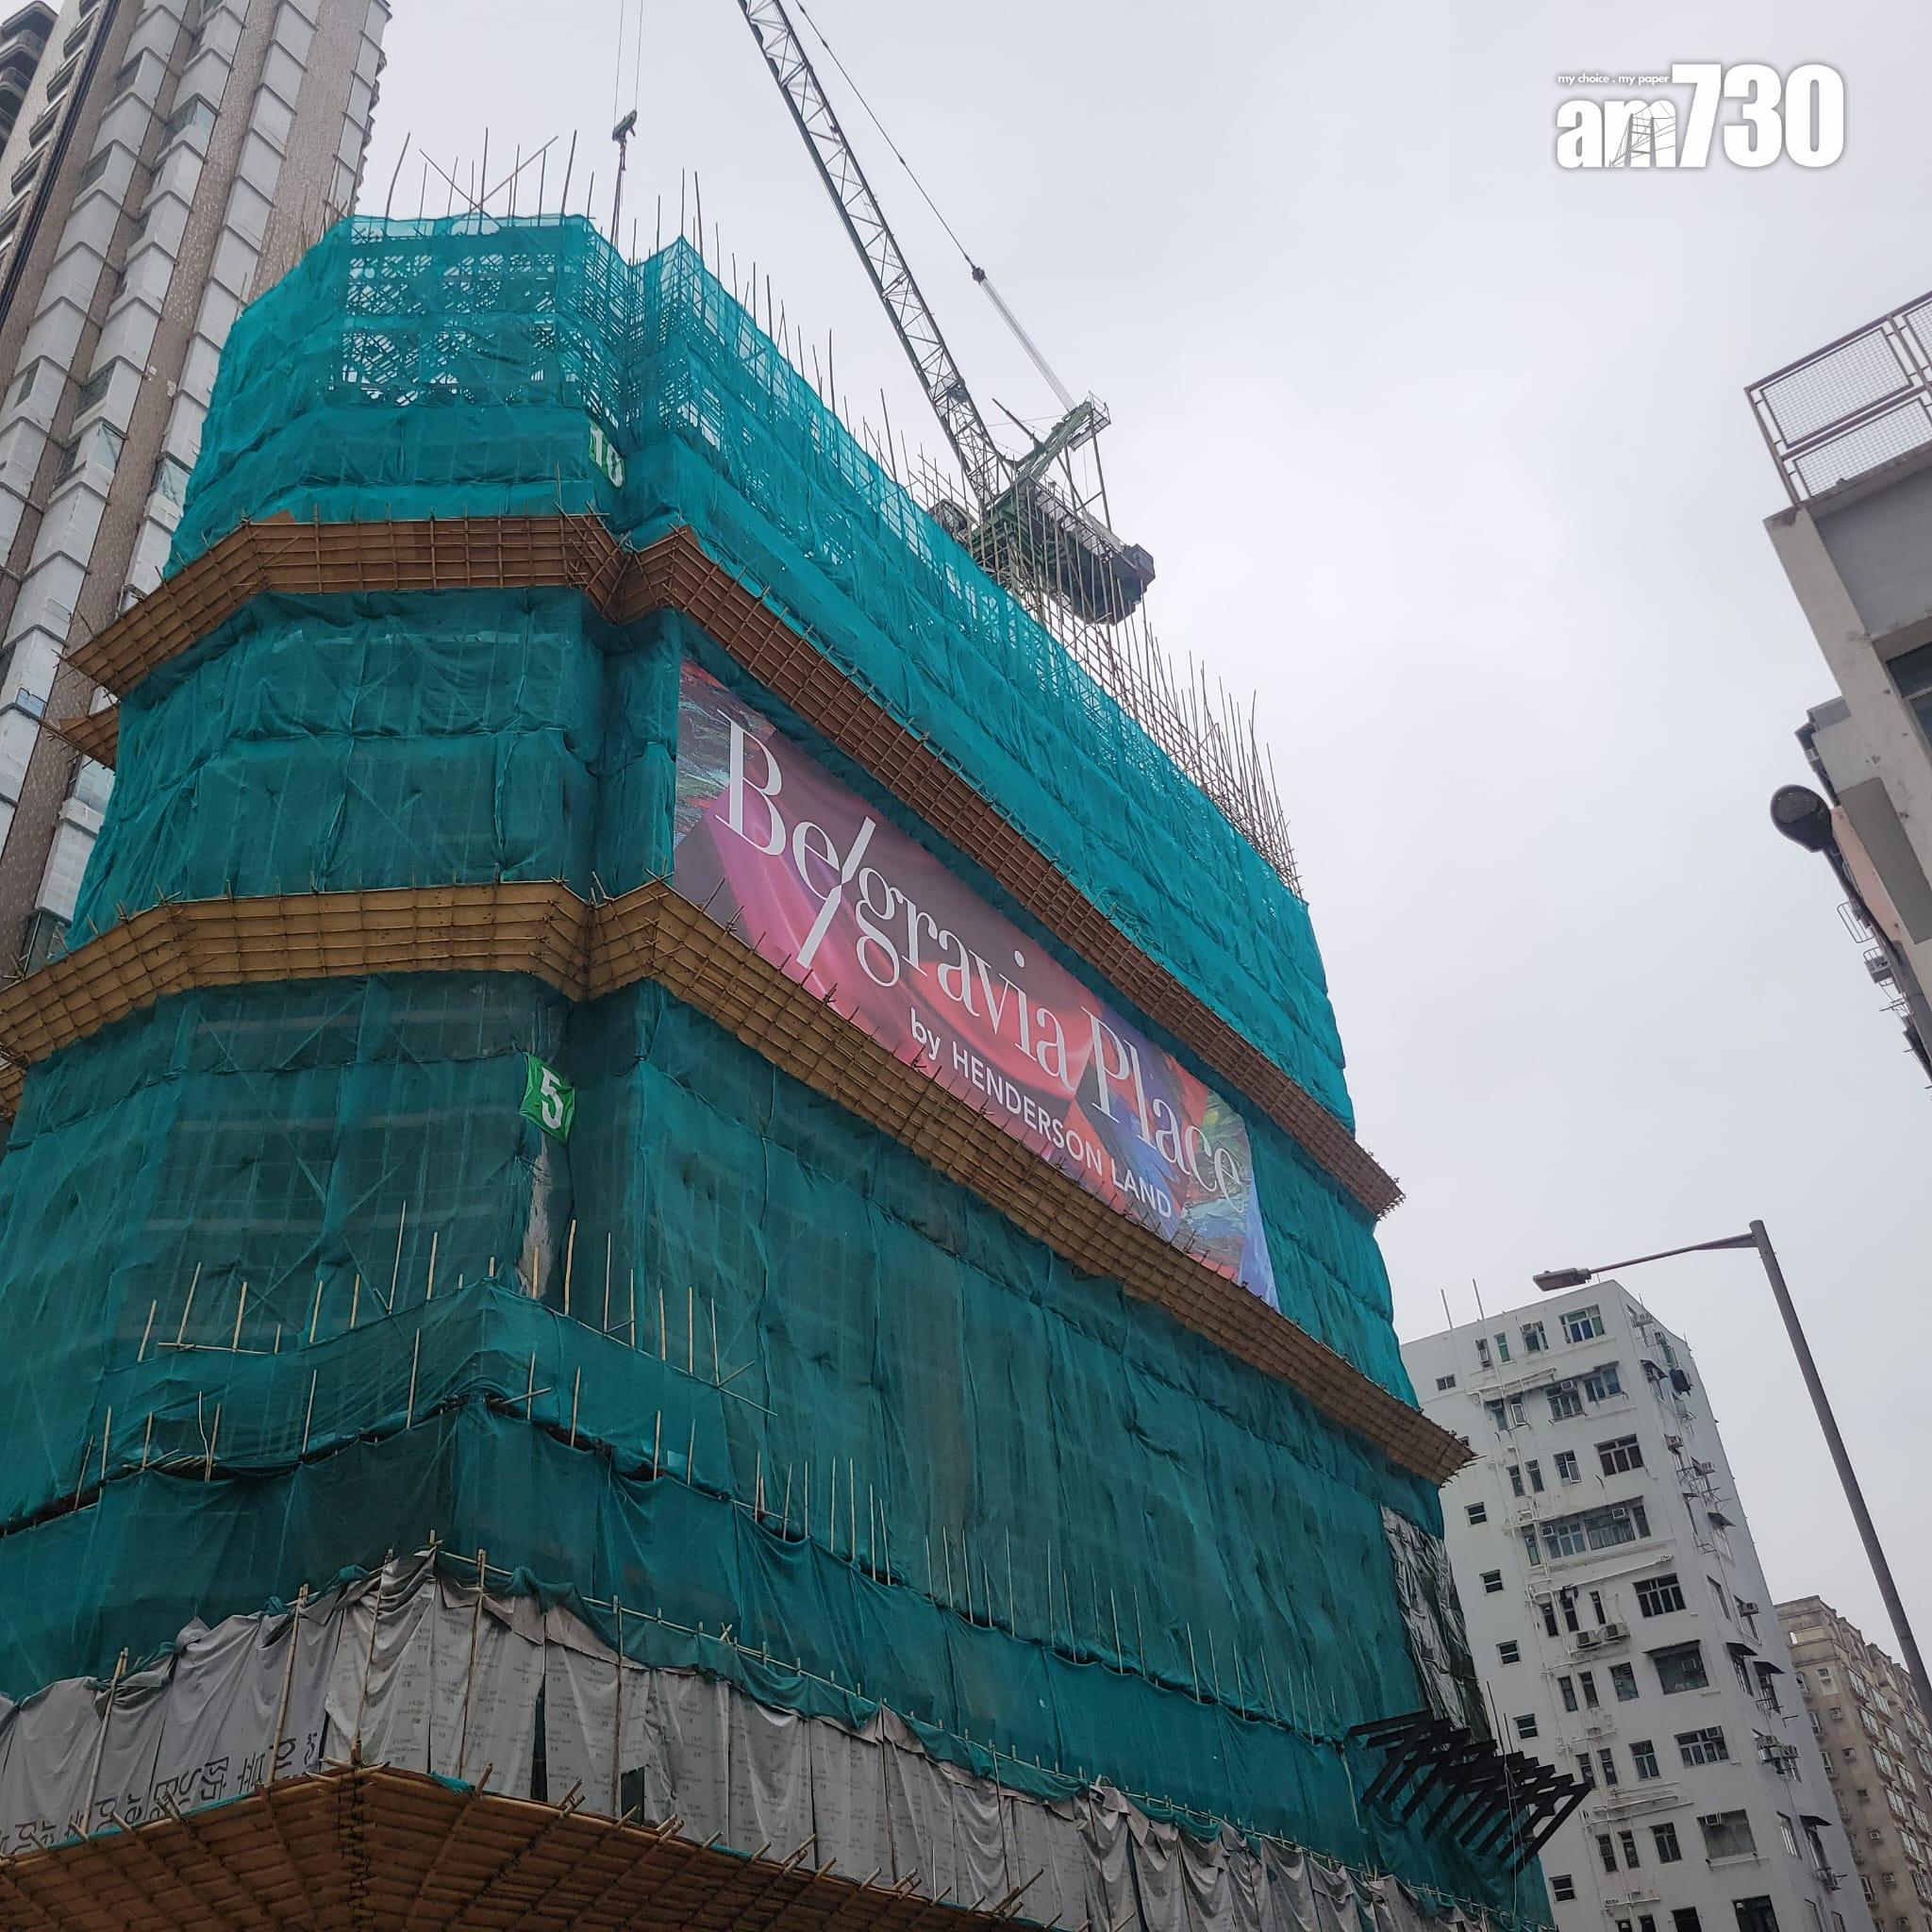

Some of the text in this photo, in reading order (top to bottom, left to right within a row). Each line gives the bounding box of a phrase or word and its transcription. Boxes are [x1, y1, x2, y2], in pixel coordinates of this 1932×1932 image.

[715, 708, 1243, 1213] Belgravia Place
[541, 1066, 563, 1129] 5
[910, 1007, 1172, 1219] by HENDERSON LAND
